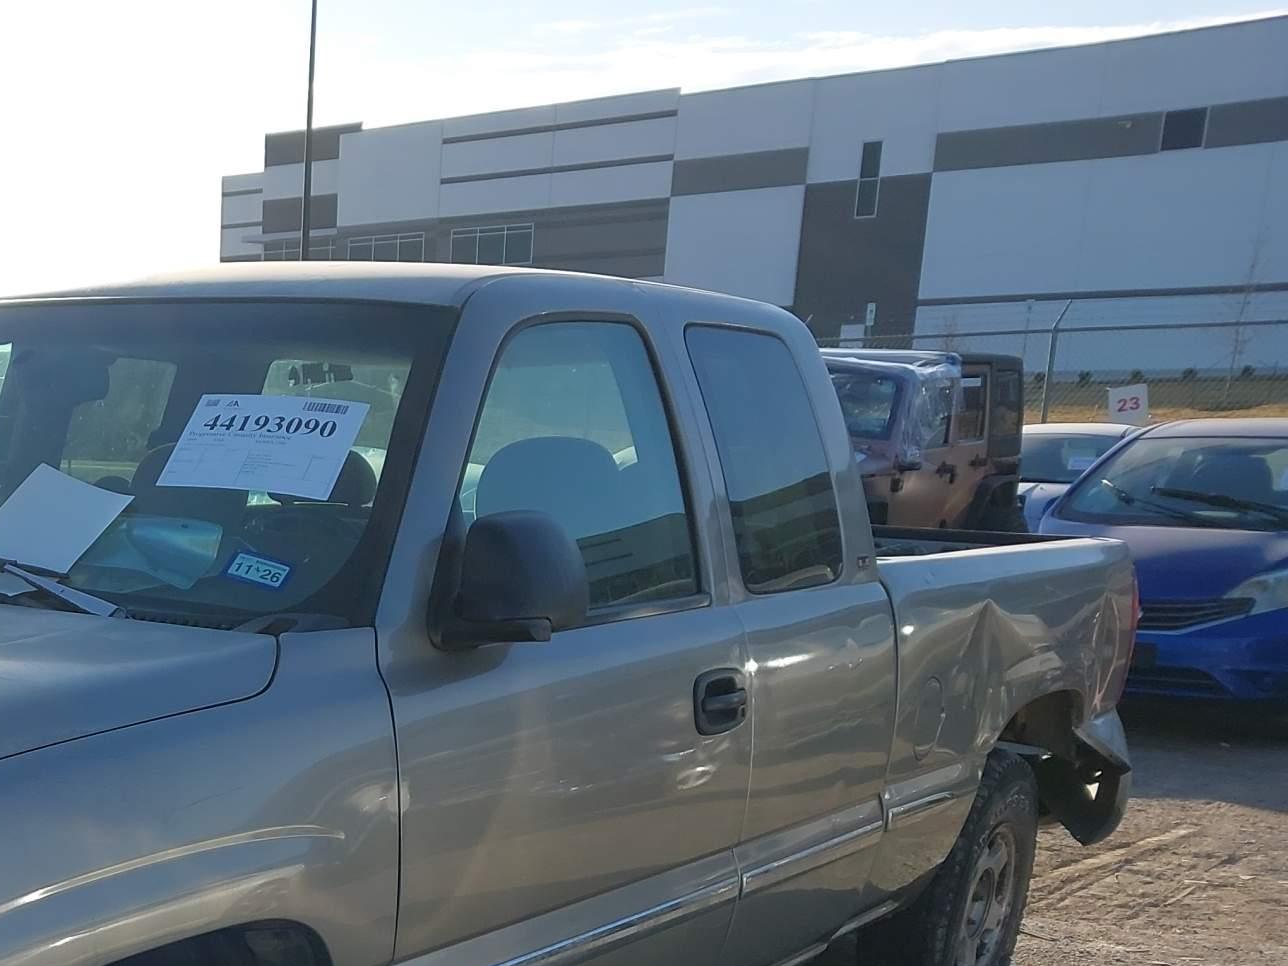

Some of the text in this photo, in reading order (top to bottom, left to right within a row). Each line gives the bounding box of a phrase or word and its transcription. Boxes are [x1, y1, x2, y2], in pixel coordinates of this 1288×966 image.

[1117, 396, 1141, 413] 23
[203, 414, 338, 438] 44193090
[234, 561, 254, 576] 11
[259, 568, 282, 583] 26
